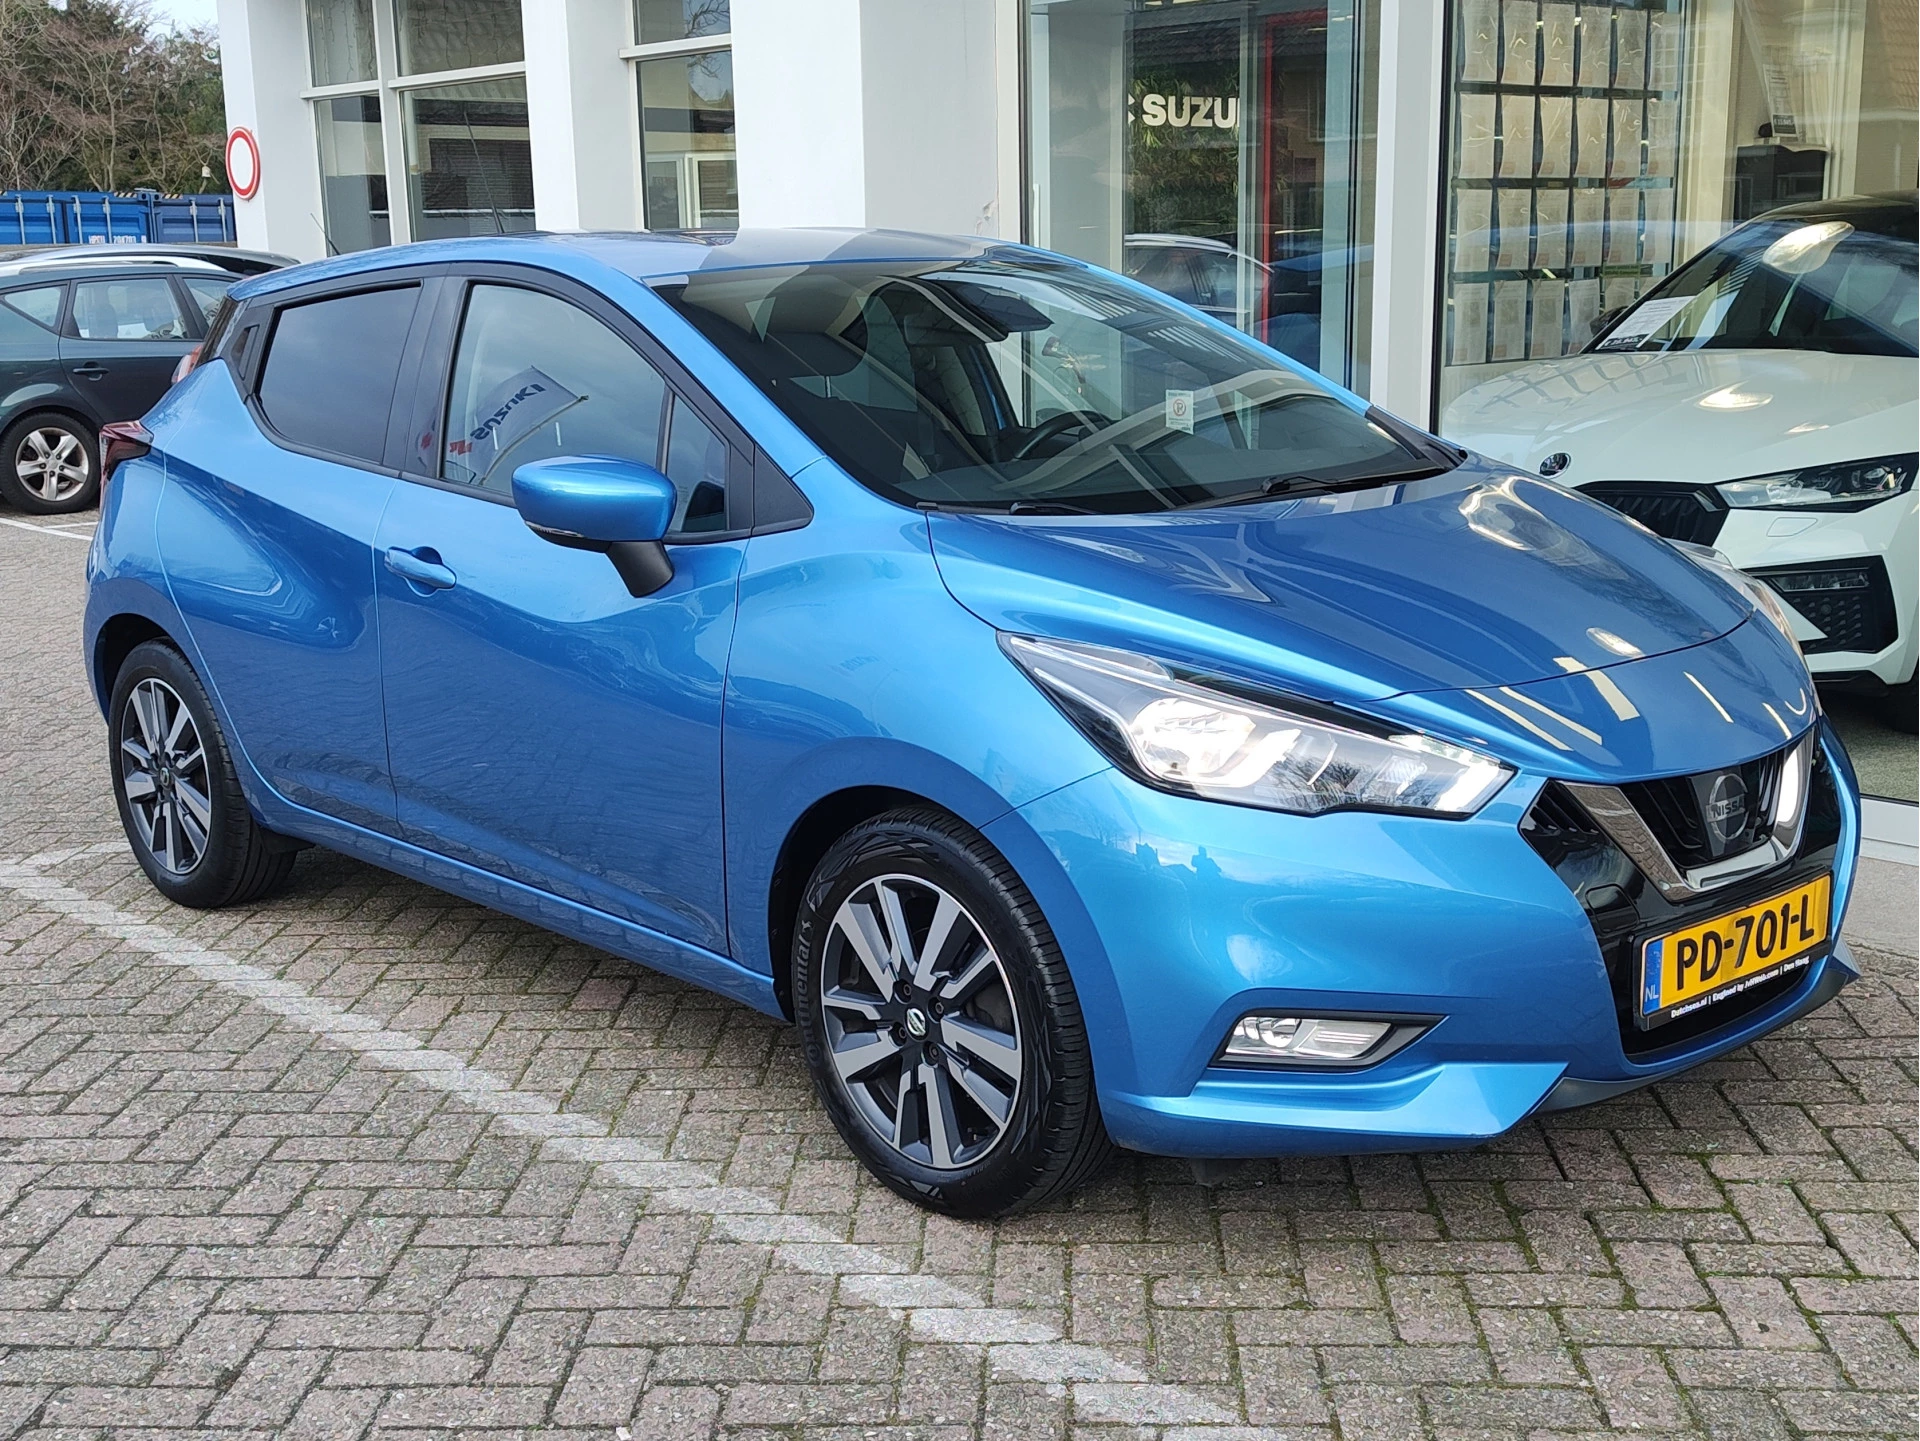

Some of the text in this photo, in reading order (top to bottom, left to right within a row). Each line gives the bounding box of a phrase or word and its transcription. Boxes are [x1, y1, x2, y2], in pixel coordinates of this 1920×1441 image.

[1142, 94, 1240, 128] SUZU
[1711, 797, 1746, 819] NISSA
[1677, 894, 1814, 991] PD-701-L
[1645, 985, 1659, 1003] NL
